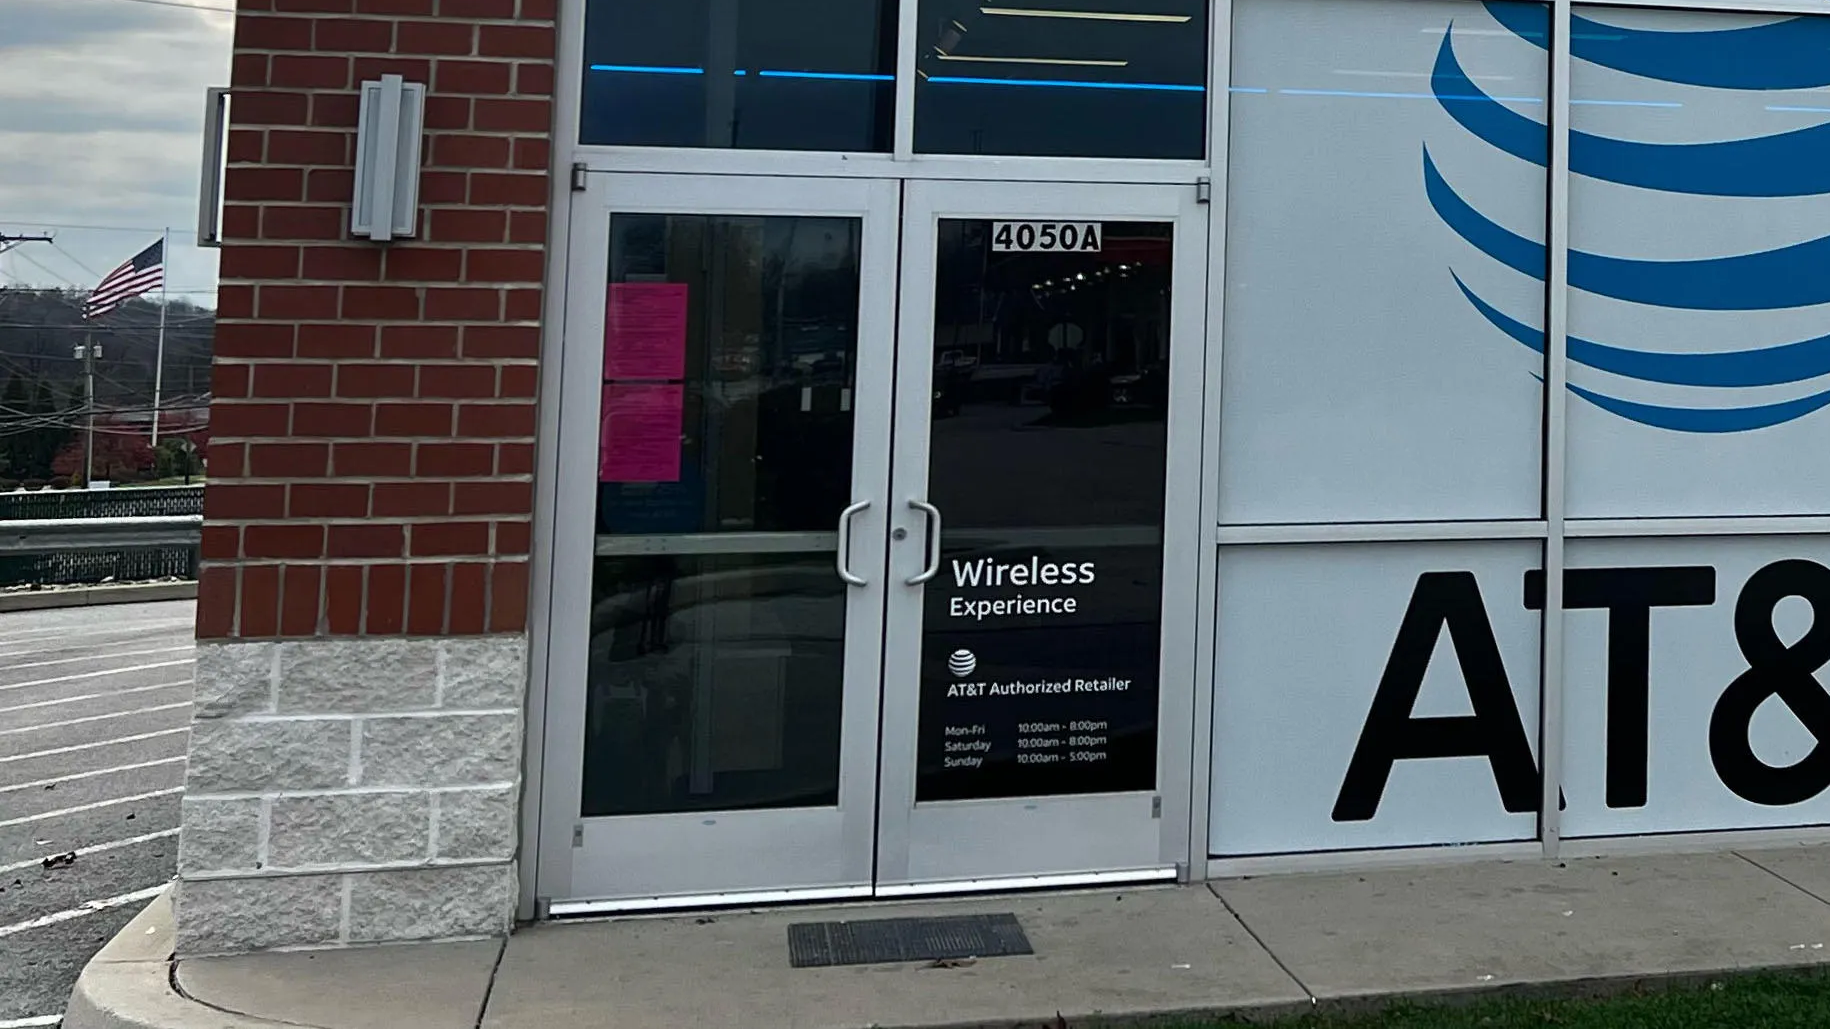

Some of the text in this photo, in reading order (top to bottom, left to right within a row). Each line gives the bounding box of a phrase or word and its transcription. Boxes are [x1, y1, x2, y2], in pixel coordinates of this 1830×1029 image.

[994, 223, 1100, 250] 4050A
[952, 556, 1095, 587] Wireless
[950, 594, 1077, 621] Experience
[947, 677, 1131, 697] AT&T Authorized Retailer
[944, 724, 986, 737] Mon-Fri
[944, 740, 992, 753] Saturday
[943, 755, 984, 768] Sunday
